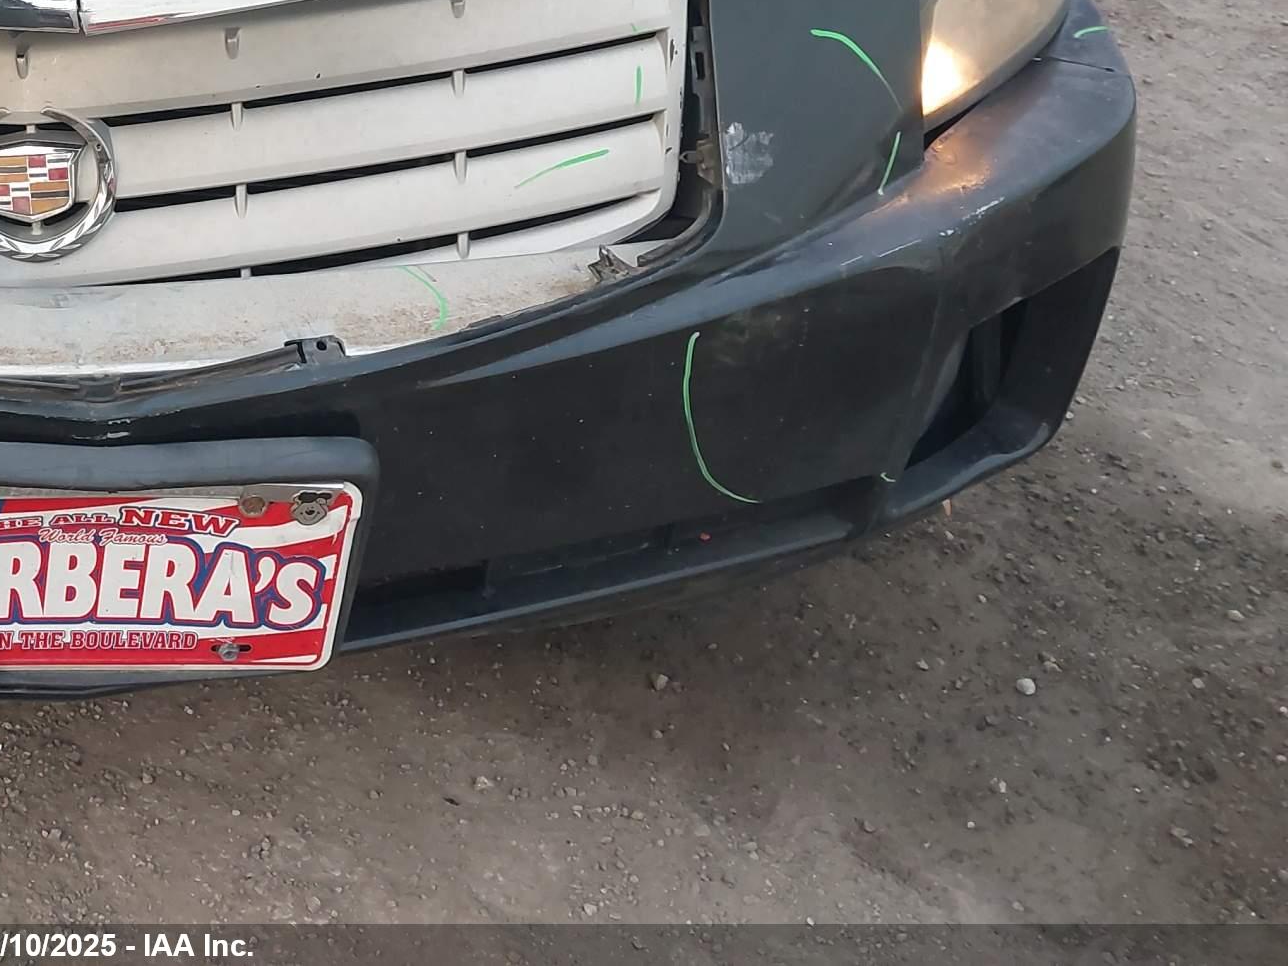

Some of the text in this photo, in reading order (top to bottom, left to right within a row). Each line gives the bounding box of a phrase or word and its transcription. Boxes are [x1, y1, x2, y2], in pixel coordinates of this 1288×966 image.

[51, 513, 116, 526] ALL
[120, 507, 239, 536] NEW
[38, 528, 167, 545] World Famous
[21, 631, 64, 649] THE
[70, 630, 198, 649] BOULEVARD
